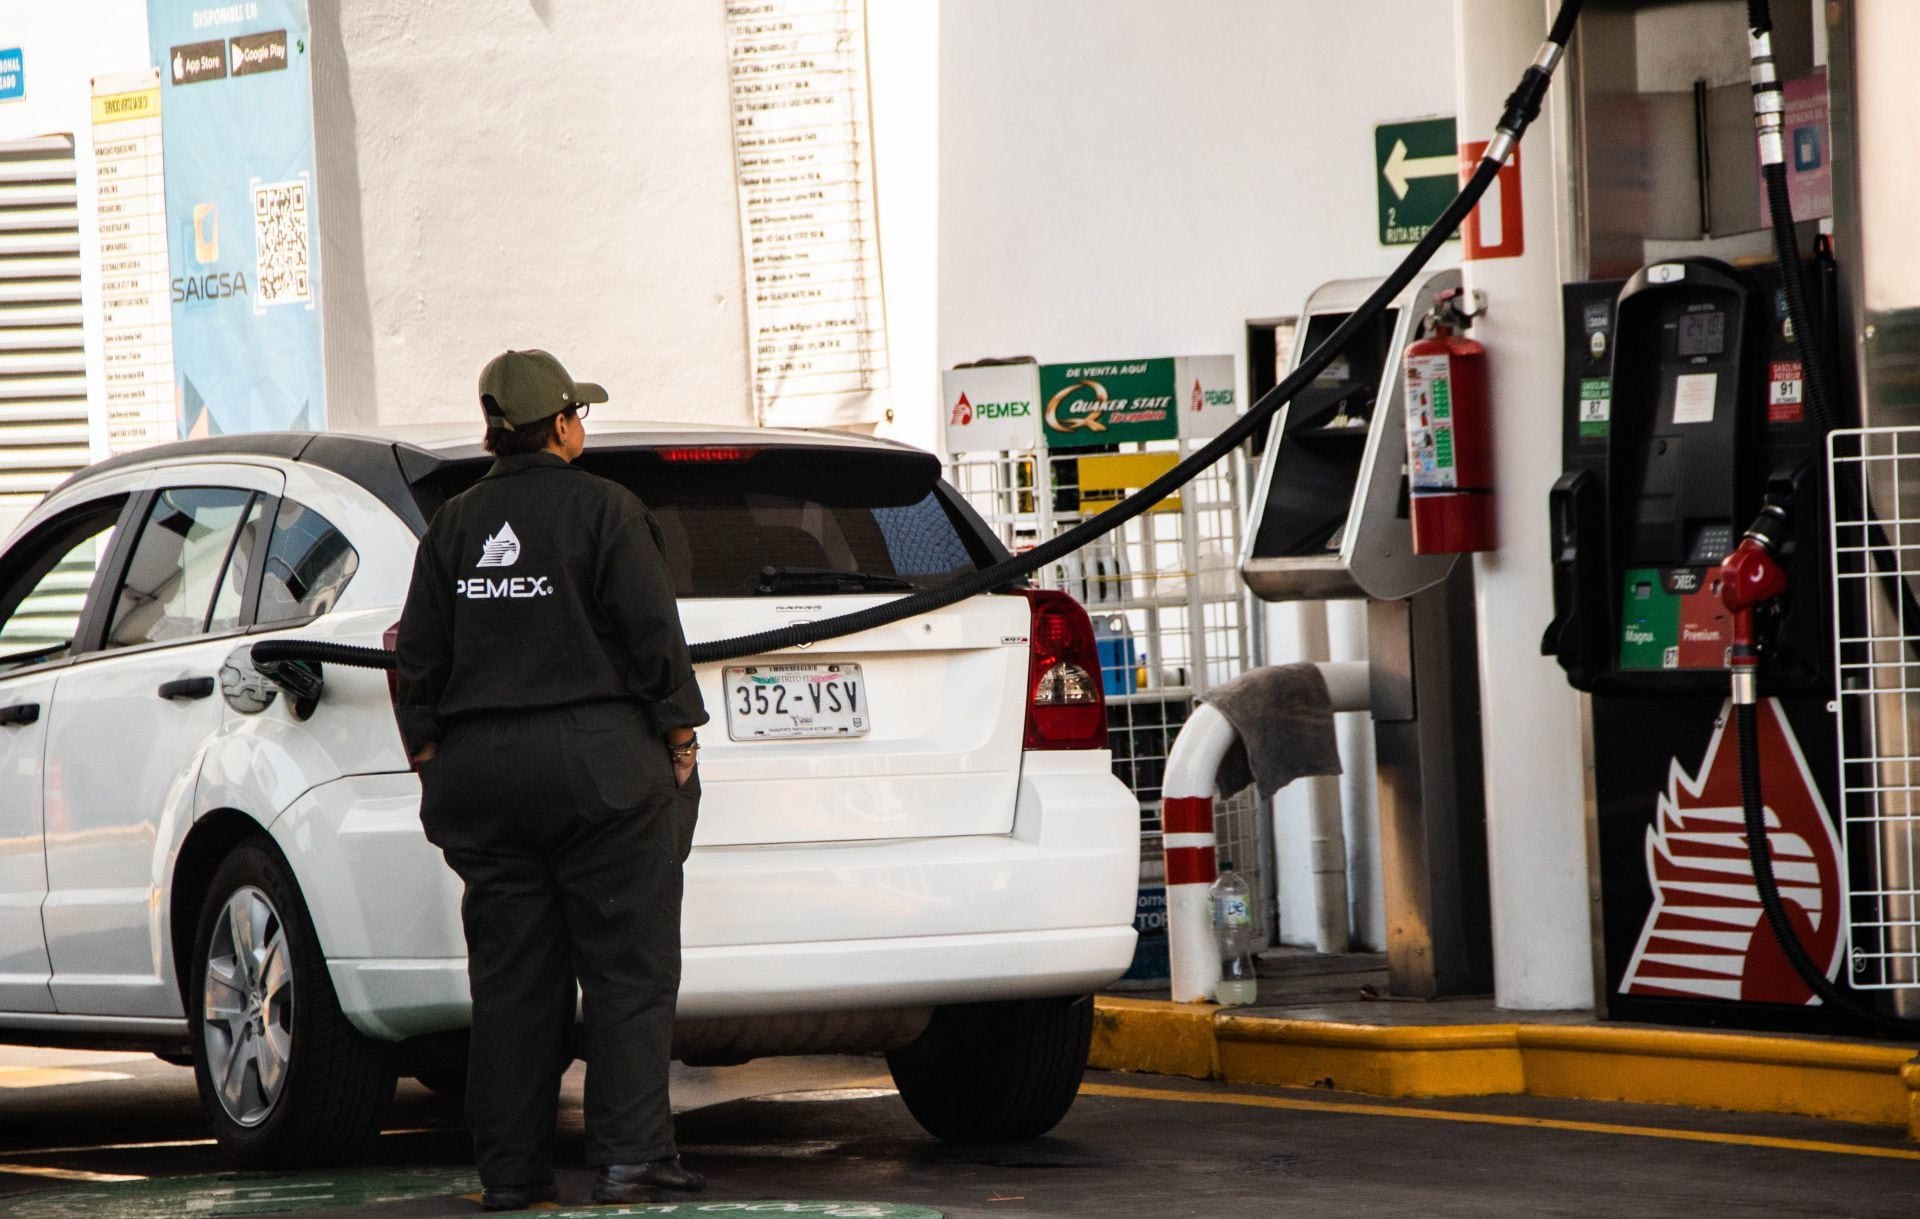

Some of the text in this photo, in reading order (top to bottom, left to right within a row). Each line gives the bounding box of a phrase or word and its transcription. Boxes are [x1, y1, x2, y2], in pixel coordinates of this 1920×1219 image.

[193, 2, 258, 28] DISPONIBLE EN
[244, 43, 285, 63] Google Play
[186, 56, 220, 74] App Store
[1388, 207, 1397, 226] 2
[1386, 227, 1408, 243] RUTA
[1408, 226, 1420, 242] DE
[1066, 369, 1080, 378] DE
[1083, 366, 1118, 377] VENTA
[1780, 382, 1793, 396] 91
[976, 402, 1031, 420] PEMEX
[1069, 396, 1172, 413] QUAKER STATE
[1625, 630, 1654, 645] Magna
[1684, 628, 1720, 641] Premium
[736, 682, 856, 715] 352-VSV
